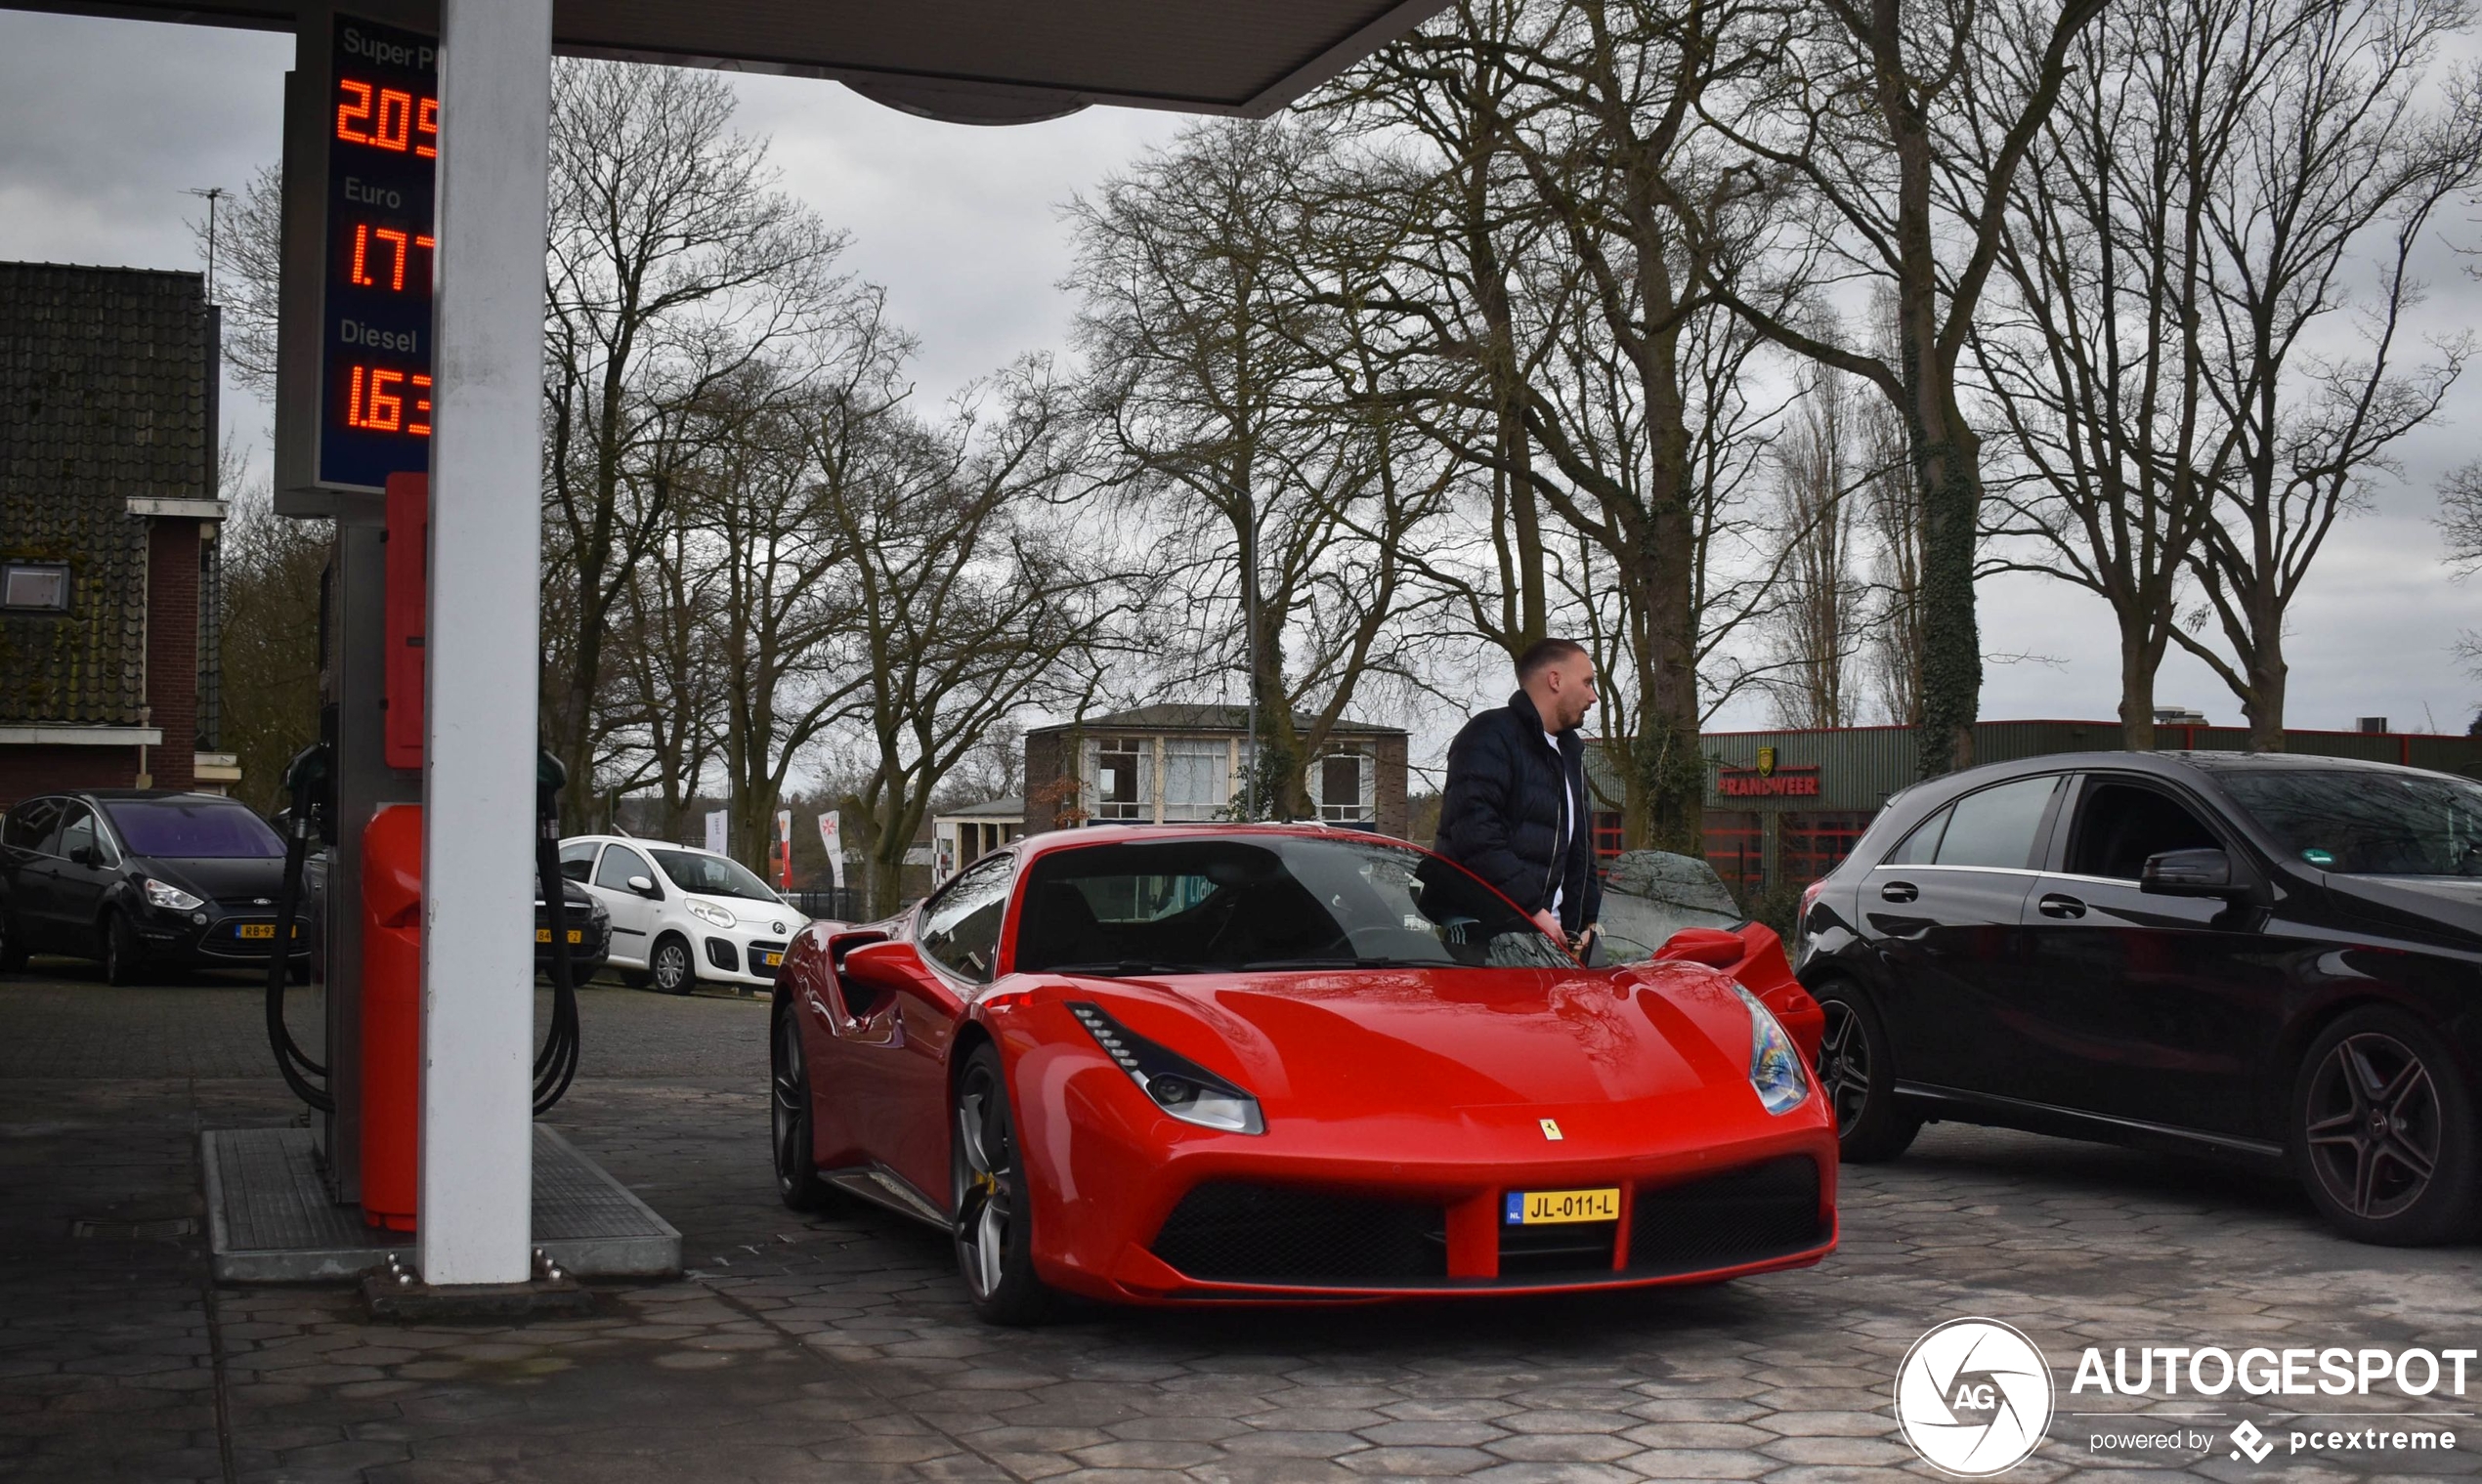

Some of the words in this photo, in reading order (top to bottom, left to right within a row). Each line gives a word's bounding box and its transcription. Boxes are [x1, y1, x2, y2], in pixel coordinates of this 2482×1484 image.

[343, 26, 415, 66] Super
[345, 176, 402, 209] Euro
[340, 318, 417, 353] Diesel
[1510, 1211, 1521, 1220] NL
[1530, 1194, 1613, 1218] JL-011-L
